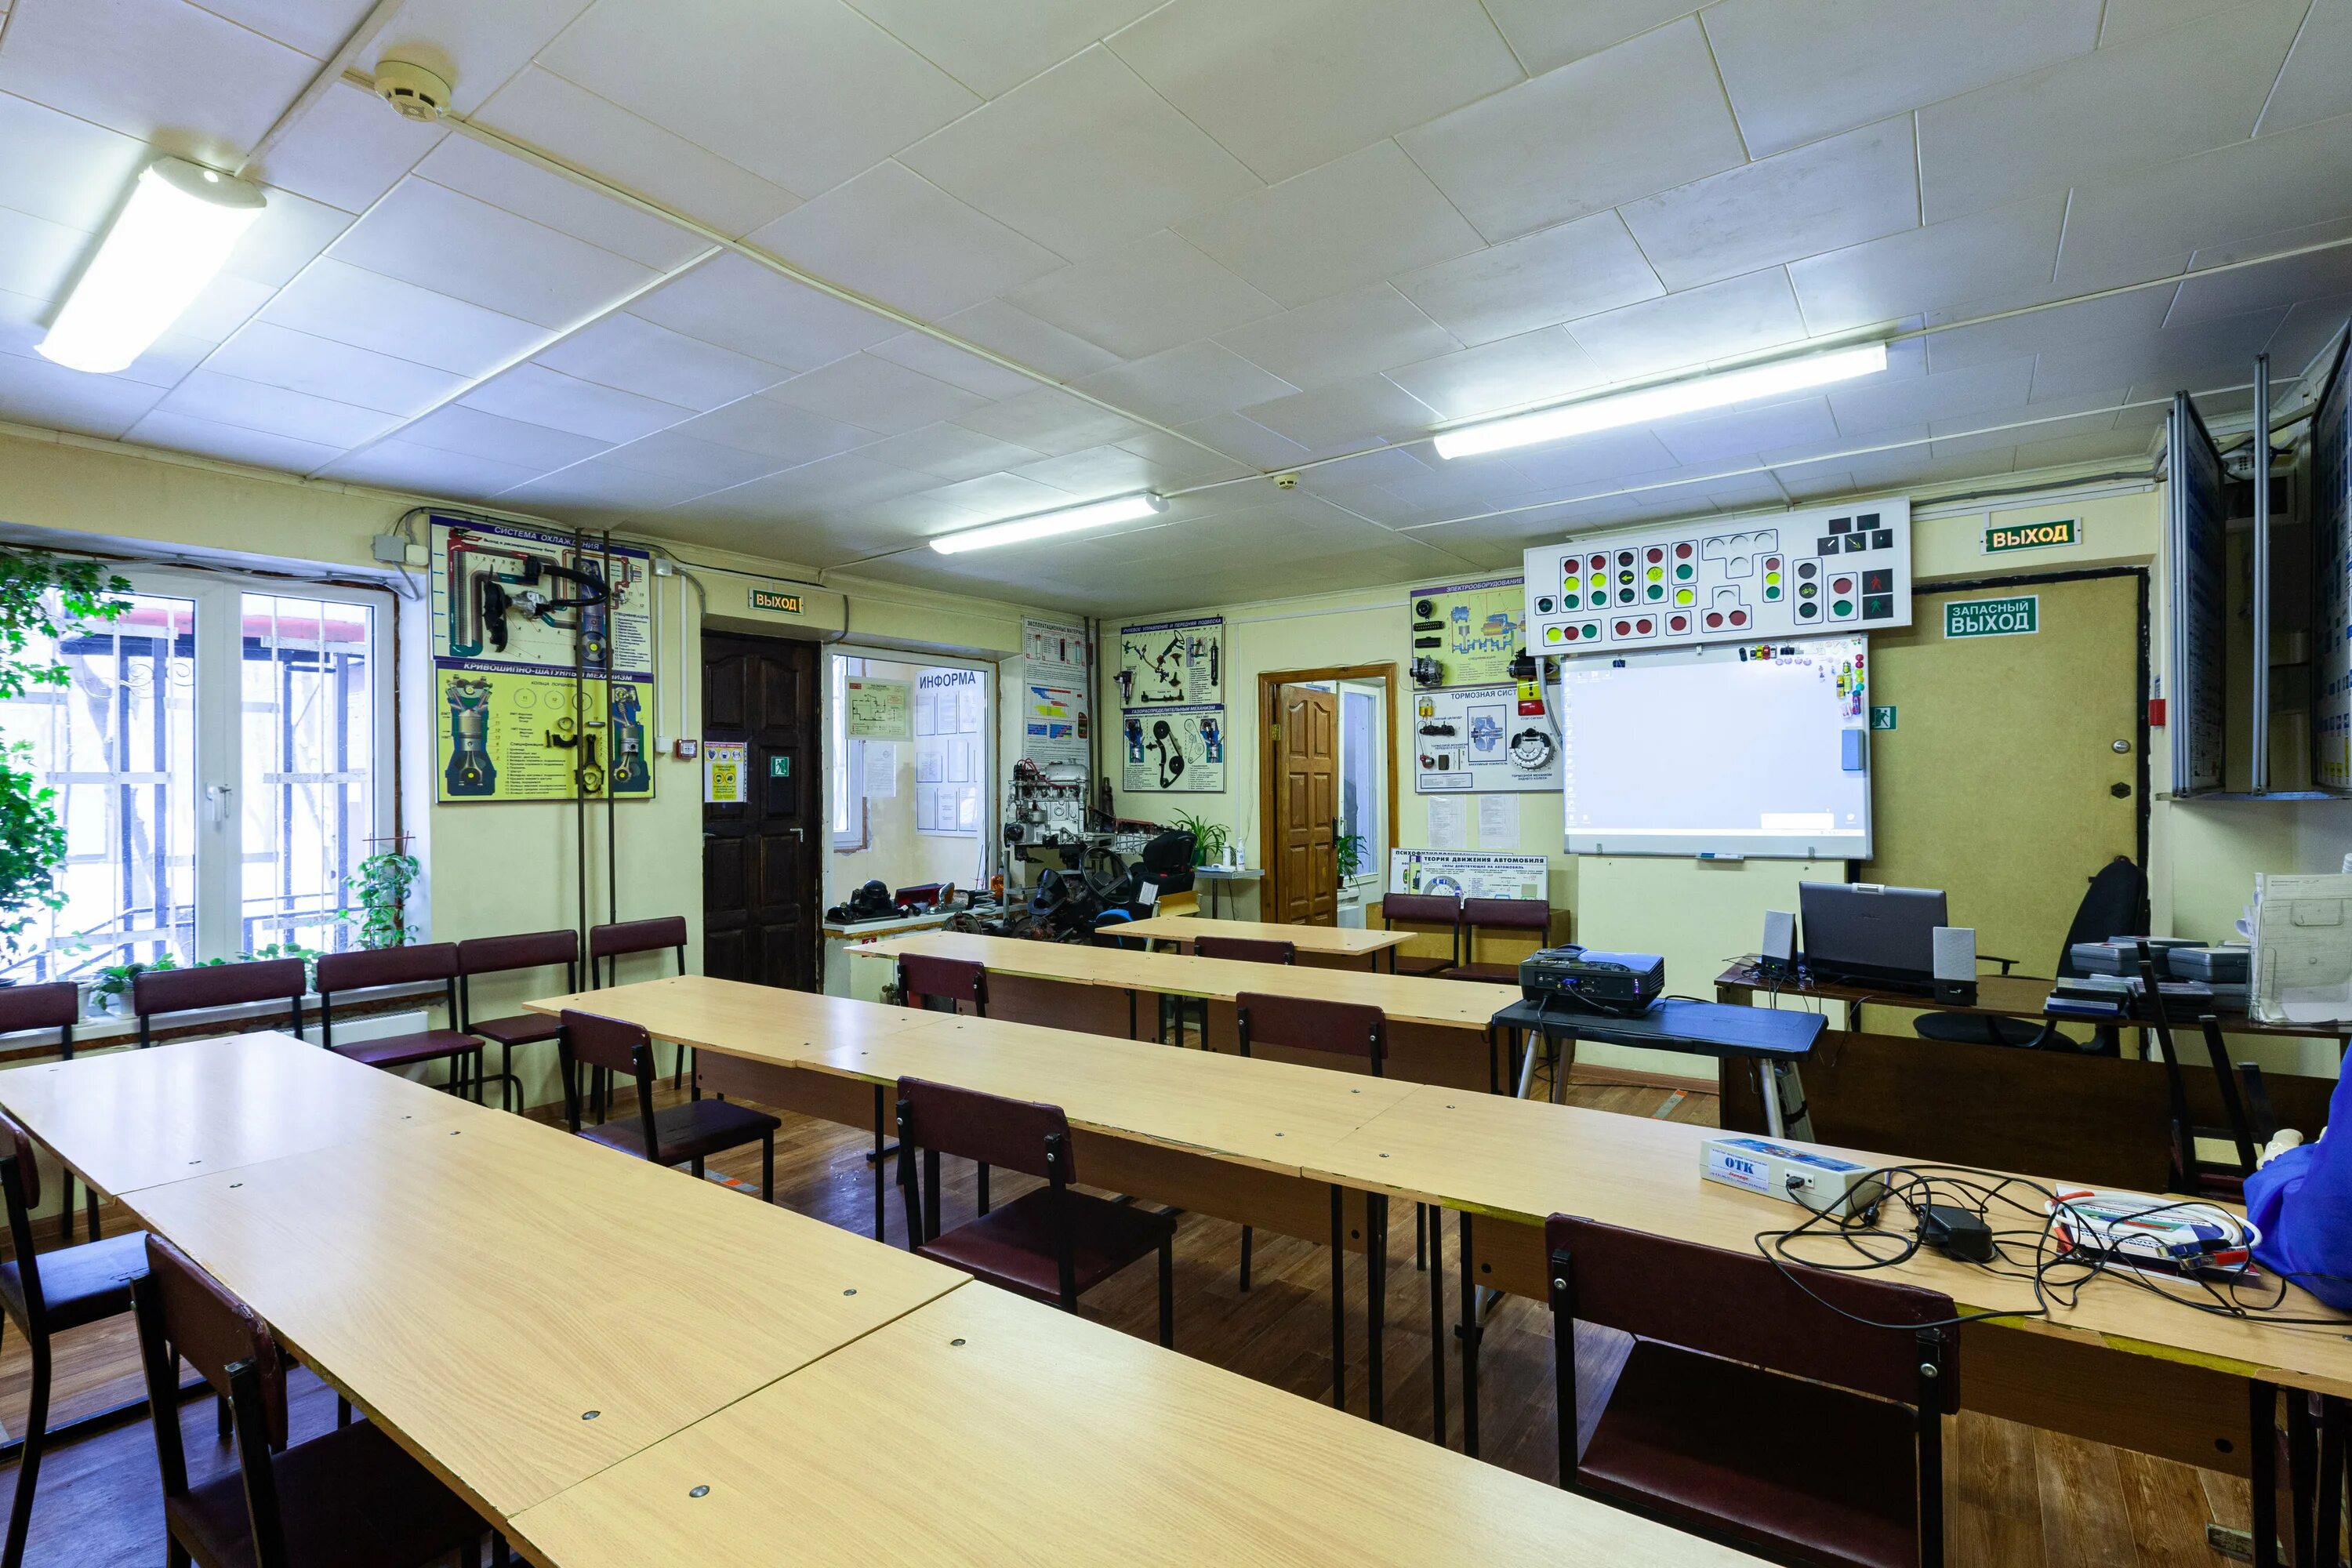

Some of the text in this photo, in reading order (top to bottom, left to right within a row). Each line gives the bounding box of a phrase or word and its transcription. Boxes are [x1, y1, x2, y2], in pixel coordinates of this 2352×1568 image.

[495, 526, 600, 550] СИСТЕМА ОХЛАЖДНИЯ
[1992, 524, 2068, 547] ВЫХОД
[1446, 578, 1523, 593] ЭЛЕКТРООБОРУДОВАНИЕ
[757, 593, 797, 612] ВЫХОД
[1952, 601, 2029, 617] ЗАПАСНЫЙ
[1951, 612, 2029, 633] ВЫХОД
[920, 672, 976, 689] ИНФОРМА
[1450, 691, 1496, 699] ТОРМОЗНАЯ
